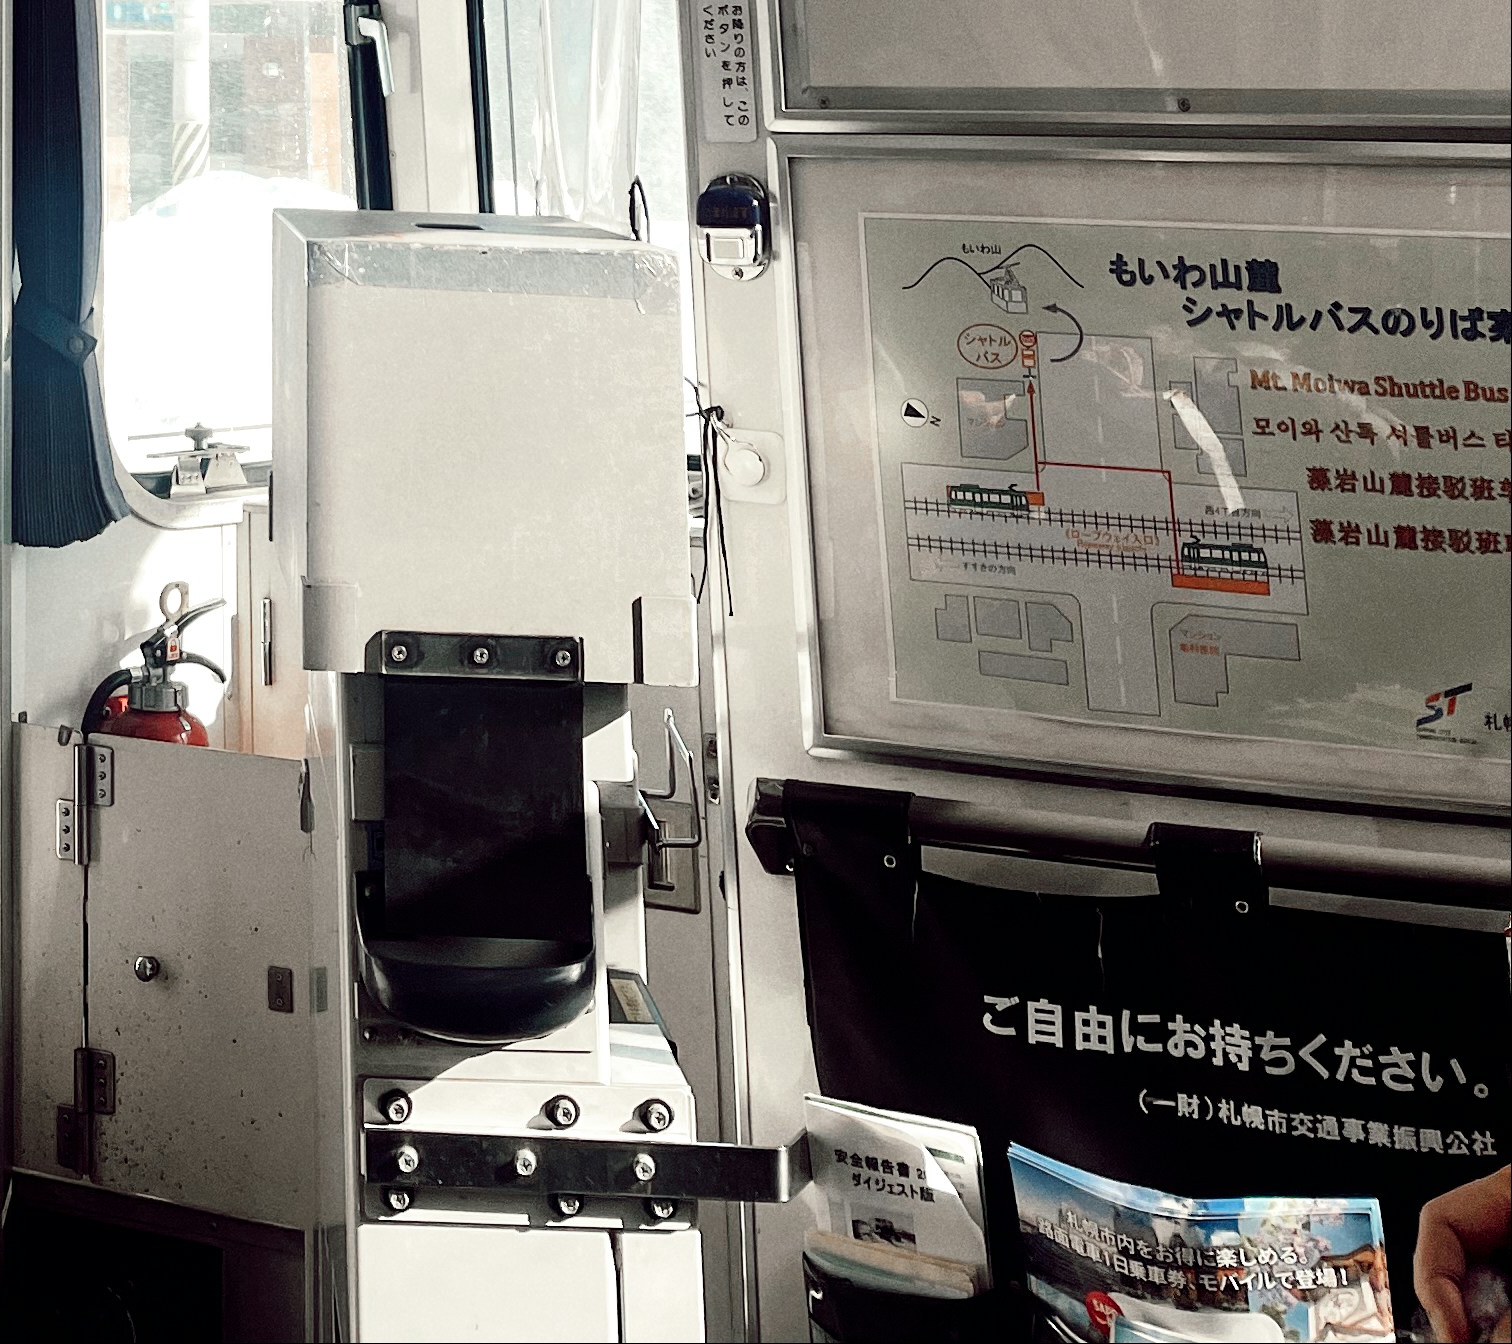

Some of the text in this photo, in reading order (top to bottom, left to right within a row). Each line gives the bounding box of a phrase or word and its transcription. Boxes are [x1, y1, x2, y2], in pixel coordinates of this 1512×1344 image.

[702, 4, 717, 59] ください
[717, 4, 736, 127] ボタンを押して
[730, 4, 751, 127] お降りの方は、この
[962, 242, 1002, 256] もいわ山
[1108, 252, 1282, 296] もいわ山麓
[964, 333, 1012, 348] シャトル
[975, 351, 1002, 363] バス
[1249, 368, 1509, 404] Mt. Moiwa Shuttle Bus
[1252, 415, 1324, 443] 모이와
[1308, 517, 1510, 555] 藻岩山麓接駁班
[981, 994, 1489, 1100] ご自由にお持ちください。
[1066, 1210, 1310, 1268] 札幌市内をお得に楽しめる。
